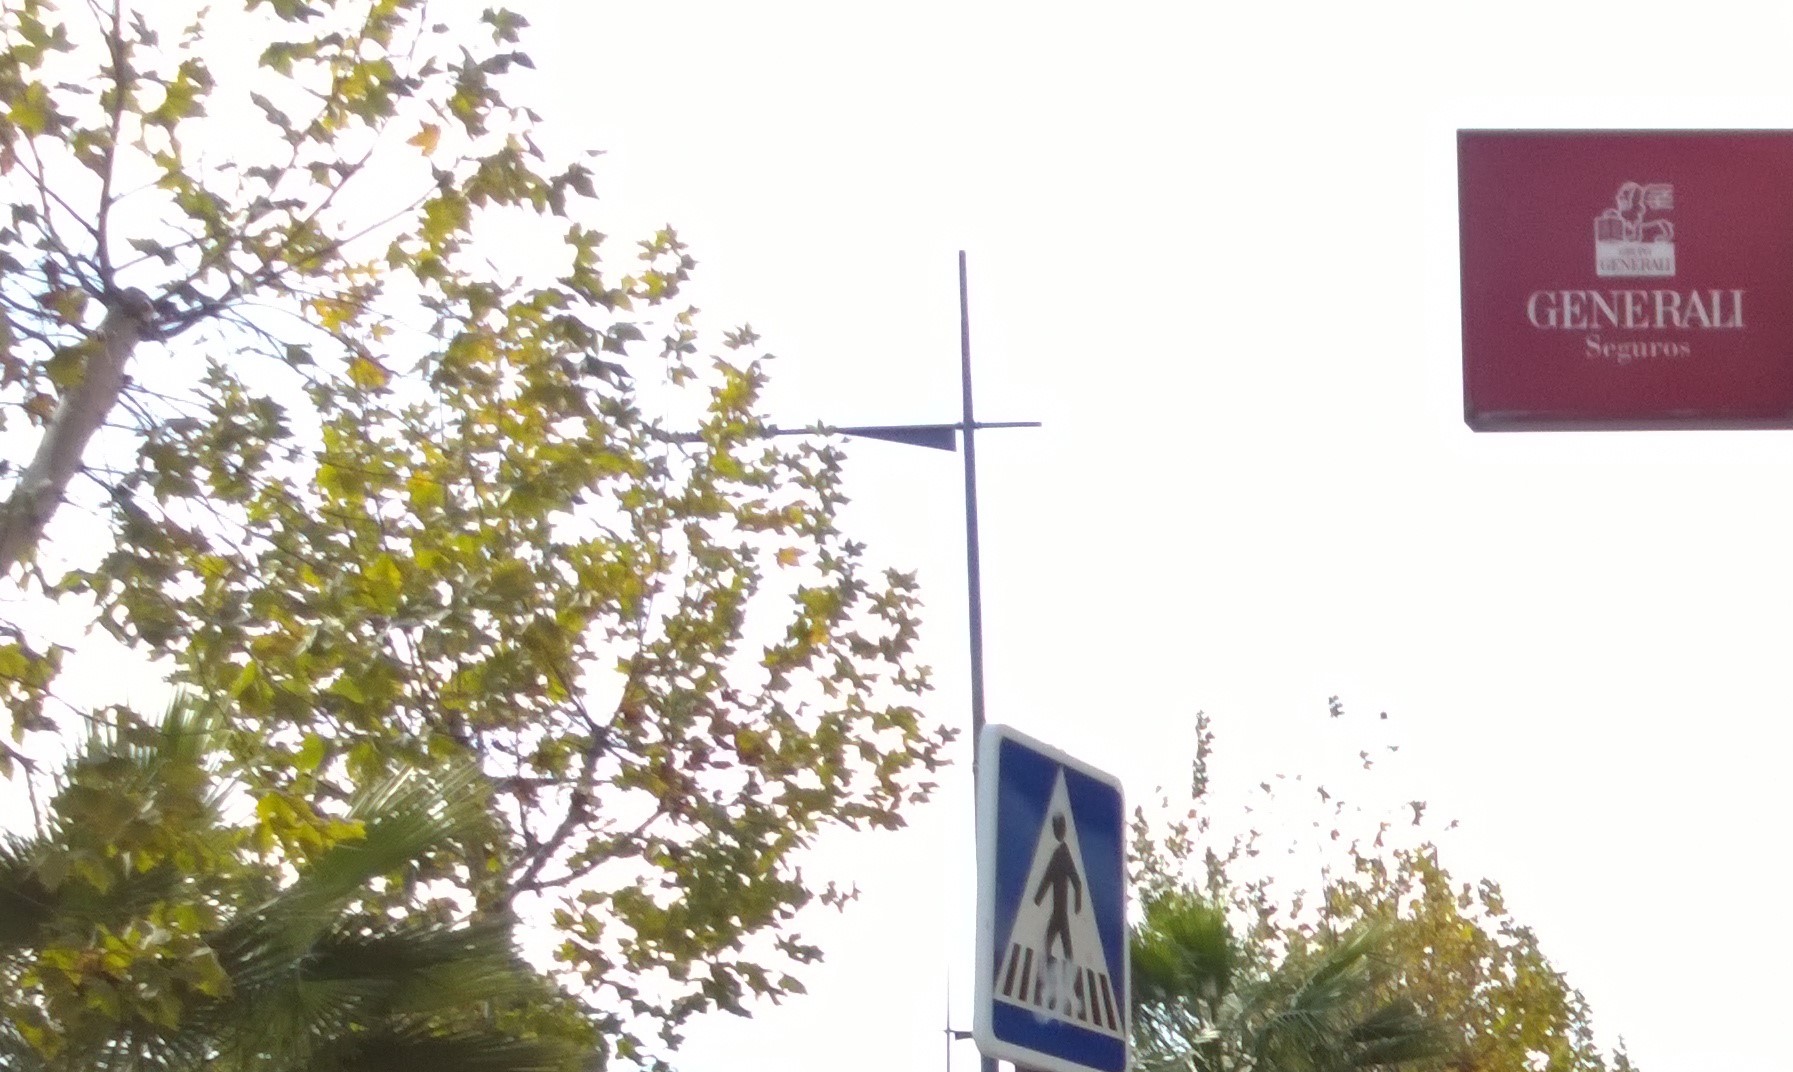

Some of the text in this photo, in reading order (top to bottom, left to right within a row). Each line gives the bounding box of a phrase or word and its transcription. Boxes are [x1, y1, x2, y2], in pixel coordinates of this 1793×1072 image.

[1599, 258, 1672, 272] GENERALI
[1526, 289, 1748, 330] GENERALI
[1585, 334, 1691, 365] Seguros
